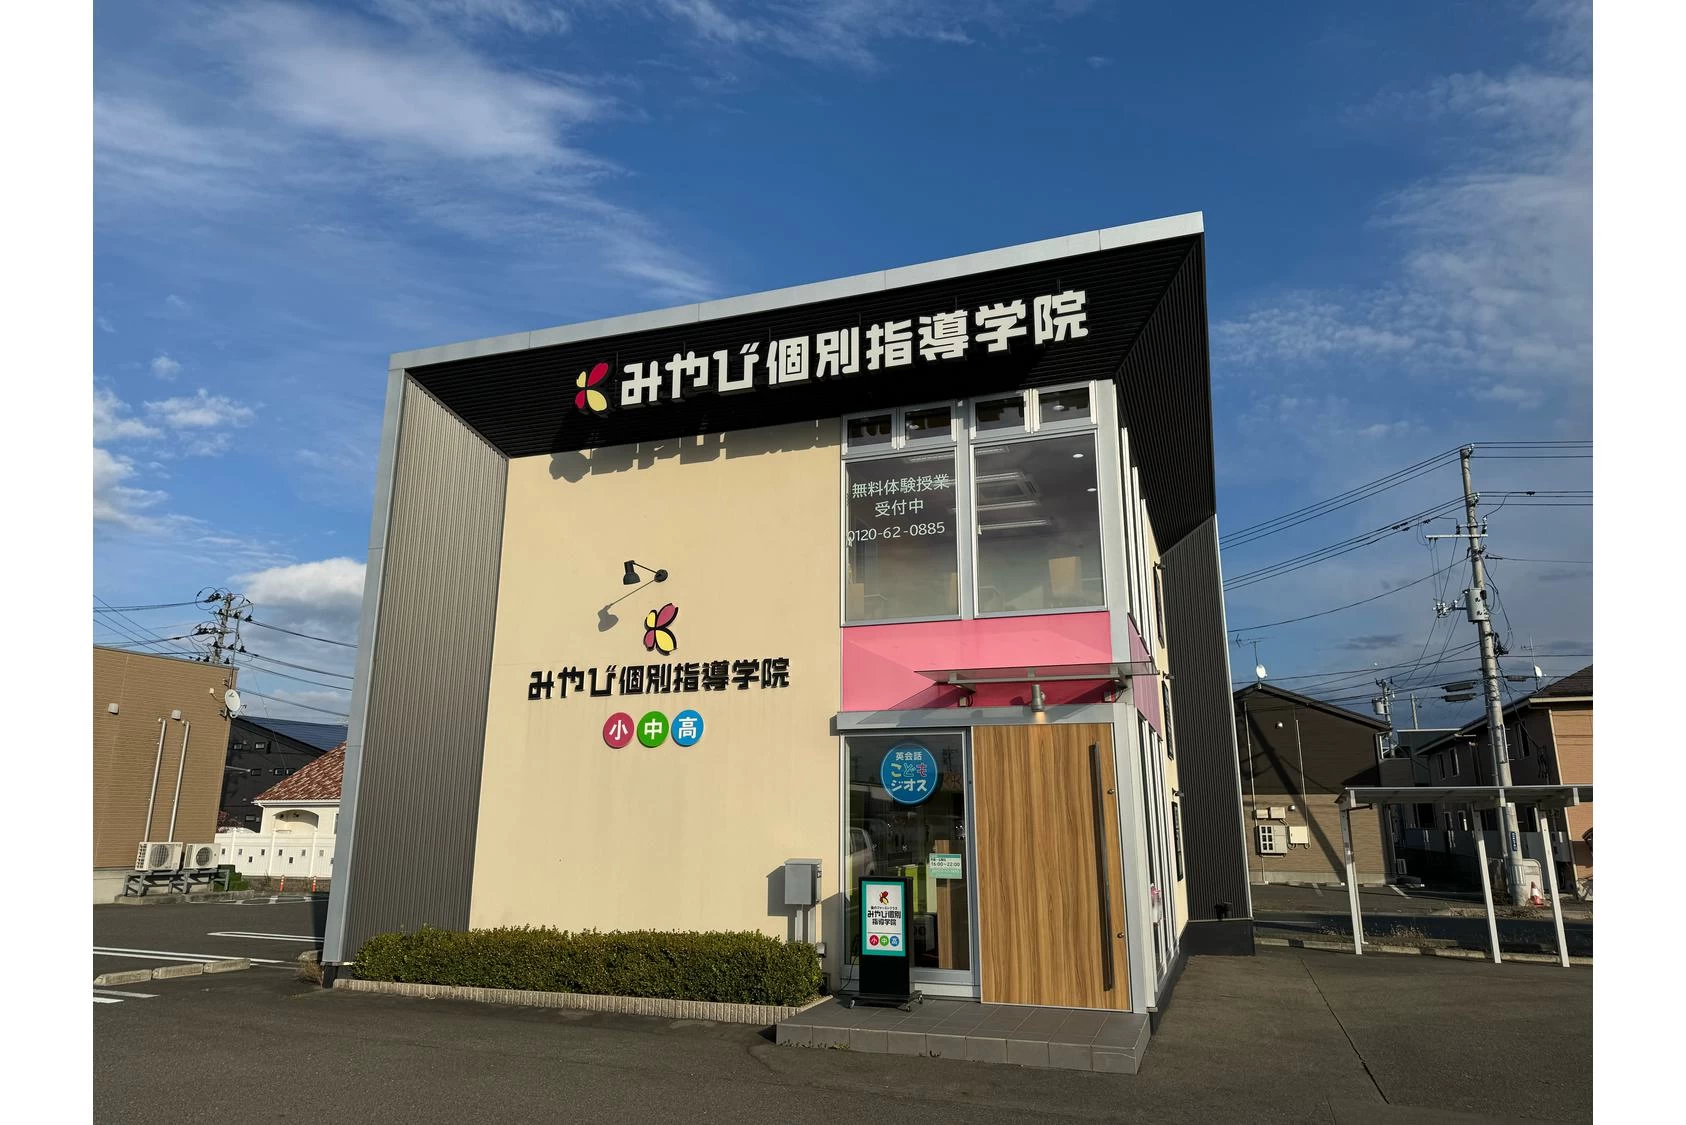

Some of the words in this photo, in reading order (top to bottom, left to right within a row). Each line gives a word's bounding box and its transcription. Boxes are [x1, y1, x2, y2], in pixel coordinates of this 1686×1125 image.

[620, 289, 1089, 407] みやび個別指導学院
[852, 473, 950, 499] 無料体験授業
[874, 498, 924, 517] 受付中
[847, 521, 946, 541] 0120-62-0885
[527, 657, 790, 701] みやび個別指導学院
[895, 751, 923, 761] 英会話
[890, 762, 928, 778] こども
[890, 778, 928, 792] ジオス
